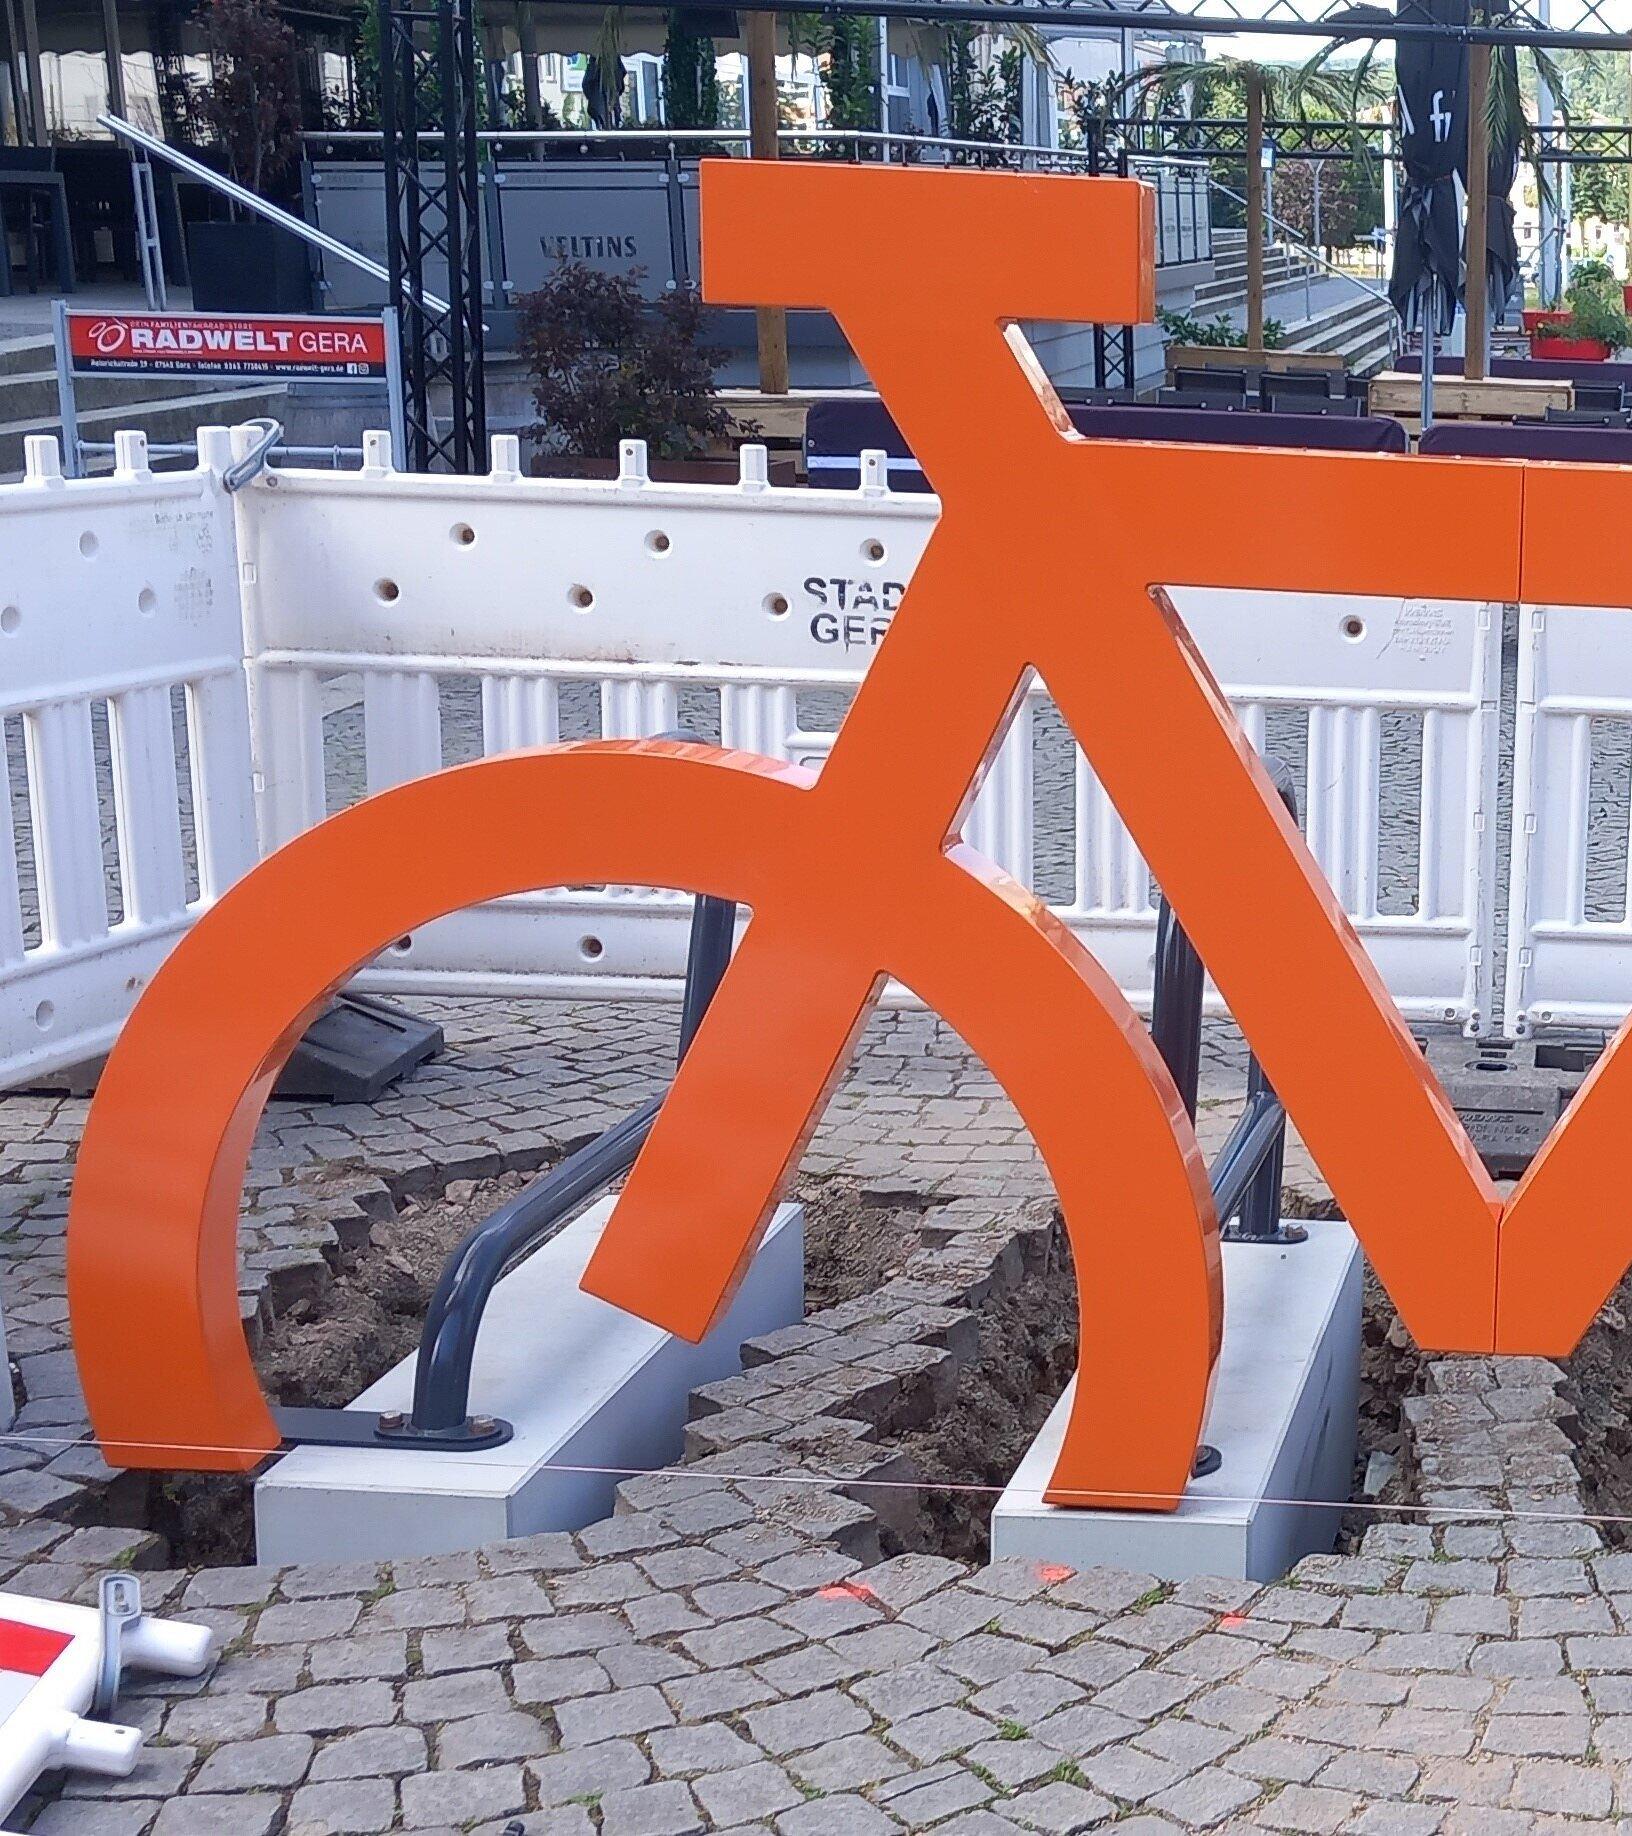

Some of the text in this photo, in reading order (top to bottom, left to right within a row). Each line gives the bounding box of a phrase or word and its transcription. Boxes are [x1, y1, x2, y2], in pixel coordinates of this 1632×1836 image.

[539, 235, 637, 258] VELTINS
[130, 328, 368, 353] RADWELT GERA
[803, 576, 906, 612] STAD
